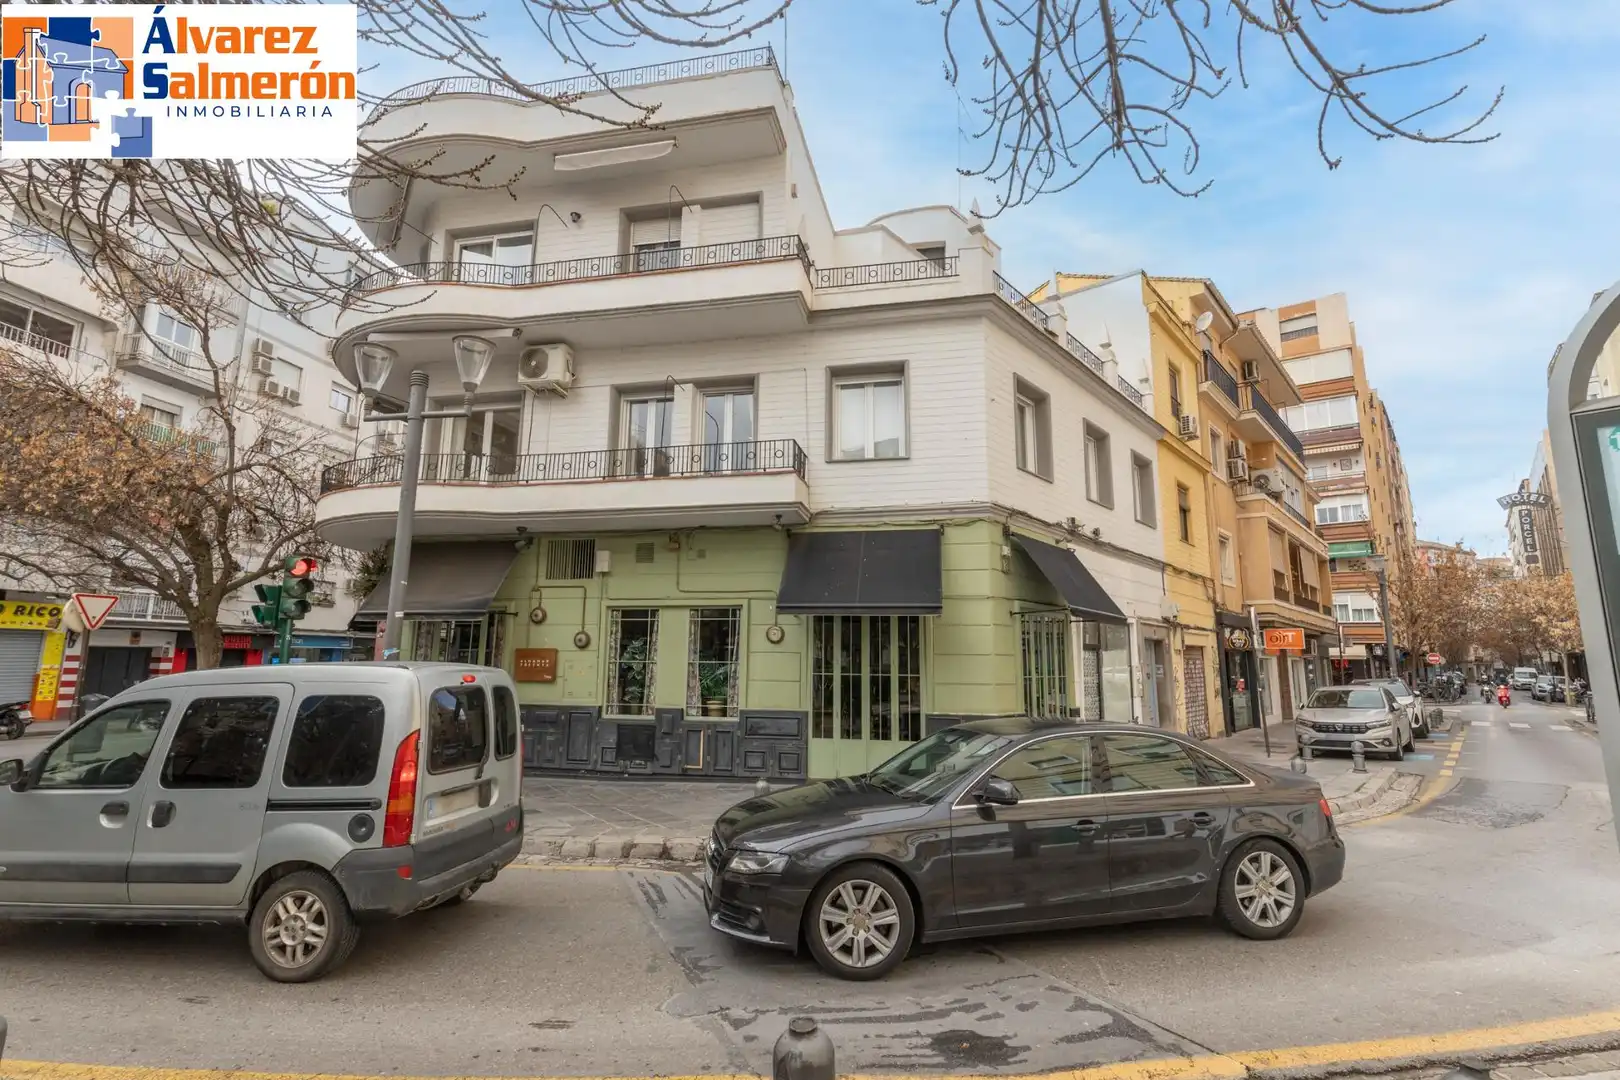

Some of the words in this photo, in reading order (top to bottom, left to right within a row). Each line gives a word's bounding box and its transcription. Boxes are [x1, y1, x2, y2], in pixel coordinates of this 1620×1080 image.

[1500, 493, 1546, 505] HOTEL
[1521, 510, 1534, 552] PORCEL
[13, 605, 61, 618] RICO
